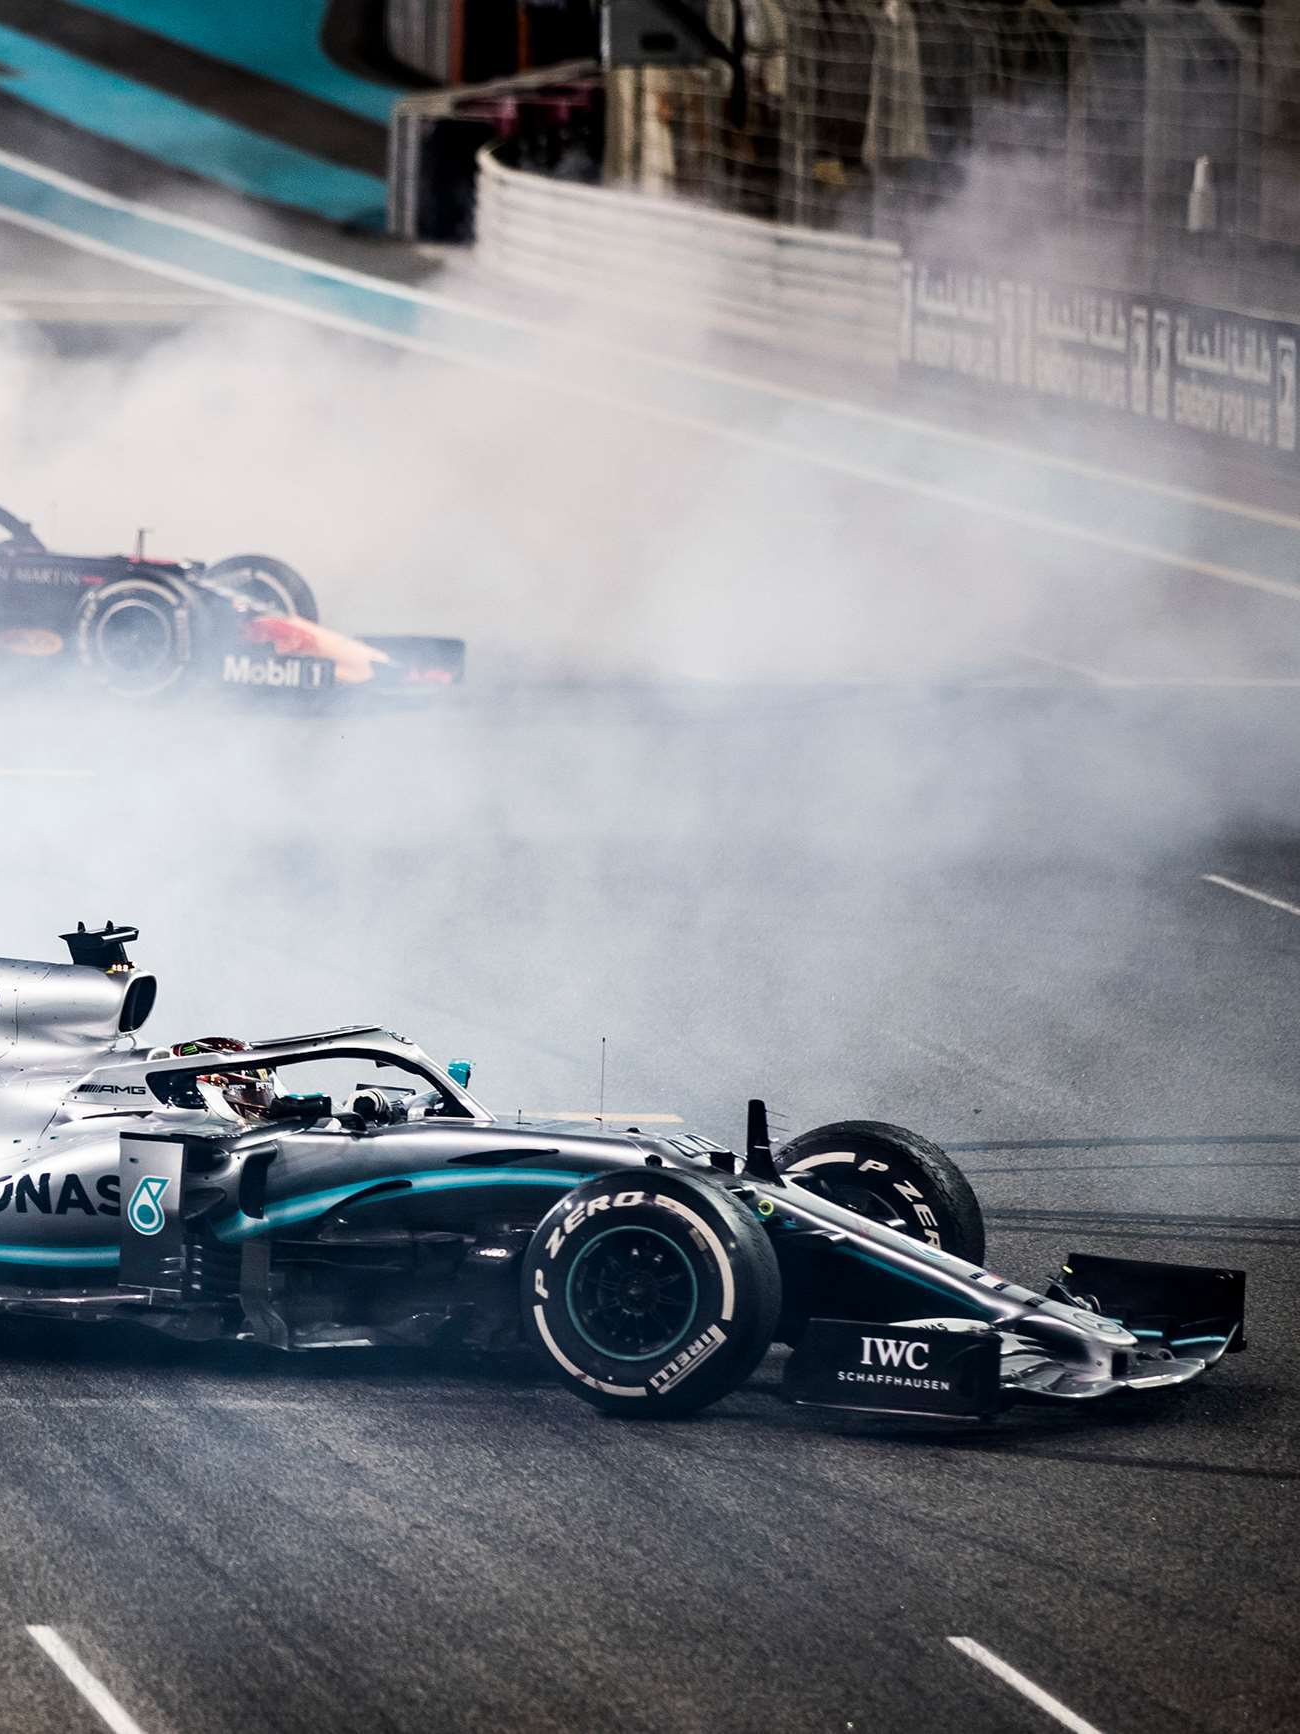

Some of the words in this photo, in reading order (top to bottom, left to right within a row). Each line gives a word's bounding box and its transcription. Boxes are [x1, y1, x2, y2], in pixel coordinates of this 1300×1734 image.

[223, 655, 299, 687] Mobil
[99, 1084, 146, 1095] AMG
[857, 1159, 889, 1172] P
[892, 1179, 941, 1251] ZER
[534, 1268, 549, 1300] P
[545, 1191, 645, 1260] ZERO
[649, 1323, 728, 1394] PIRELLI
[860, 1336, 930, 1371] IWC
[837, 1371, 950, 1391] SCHAFFHAUSEN
